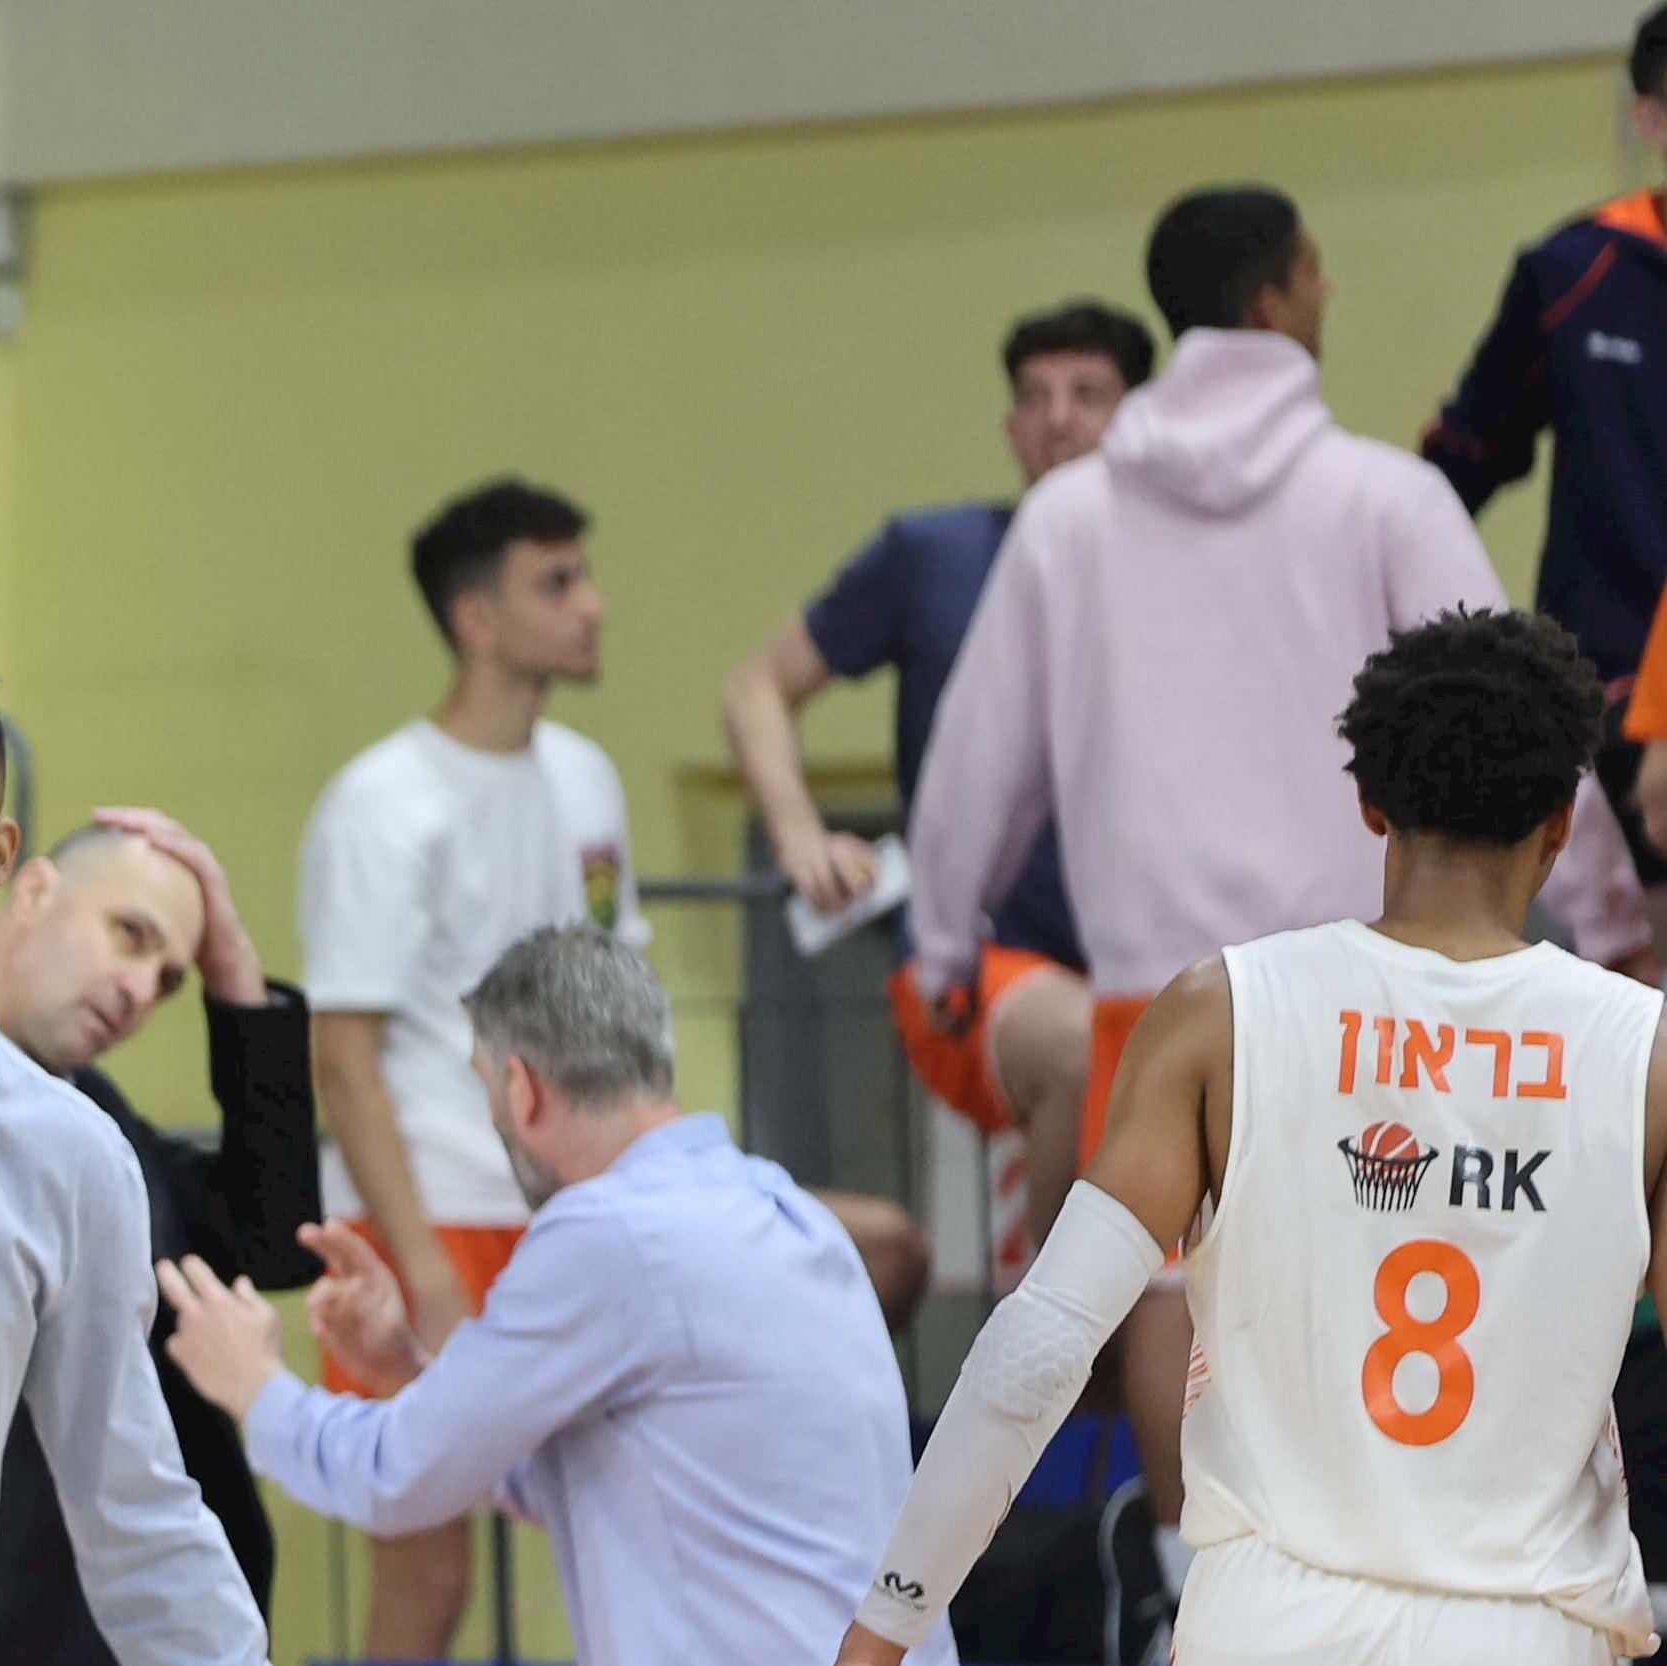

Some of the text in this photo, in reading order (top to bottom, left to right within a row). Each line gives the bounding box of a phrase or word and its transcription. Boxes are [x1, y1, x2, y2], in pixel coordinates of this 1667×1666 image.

[1337, 1008, 1568, 1100] בראון
[1448, 1143, 1554, 1212] RK
[1361, 1238, 1482, 1447] 8
